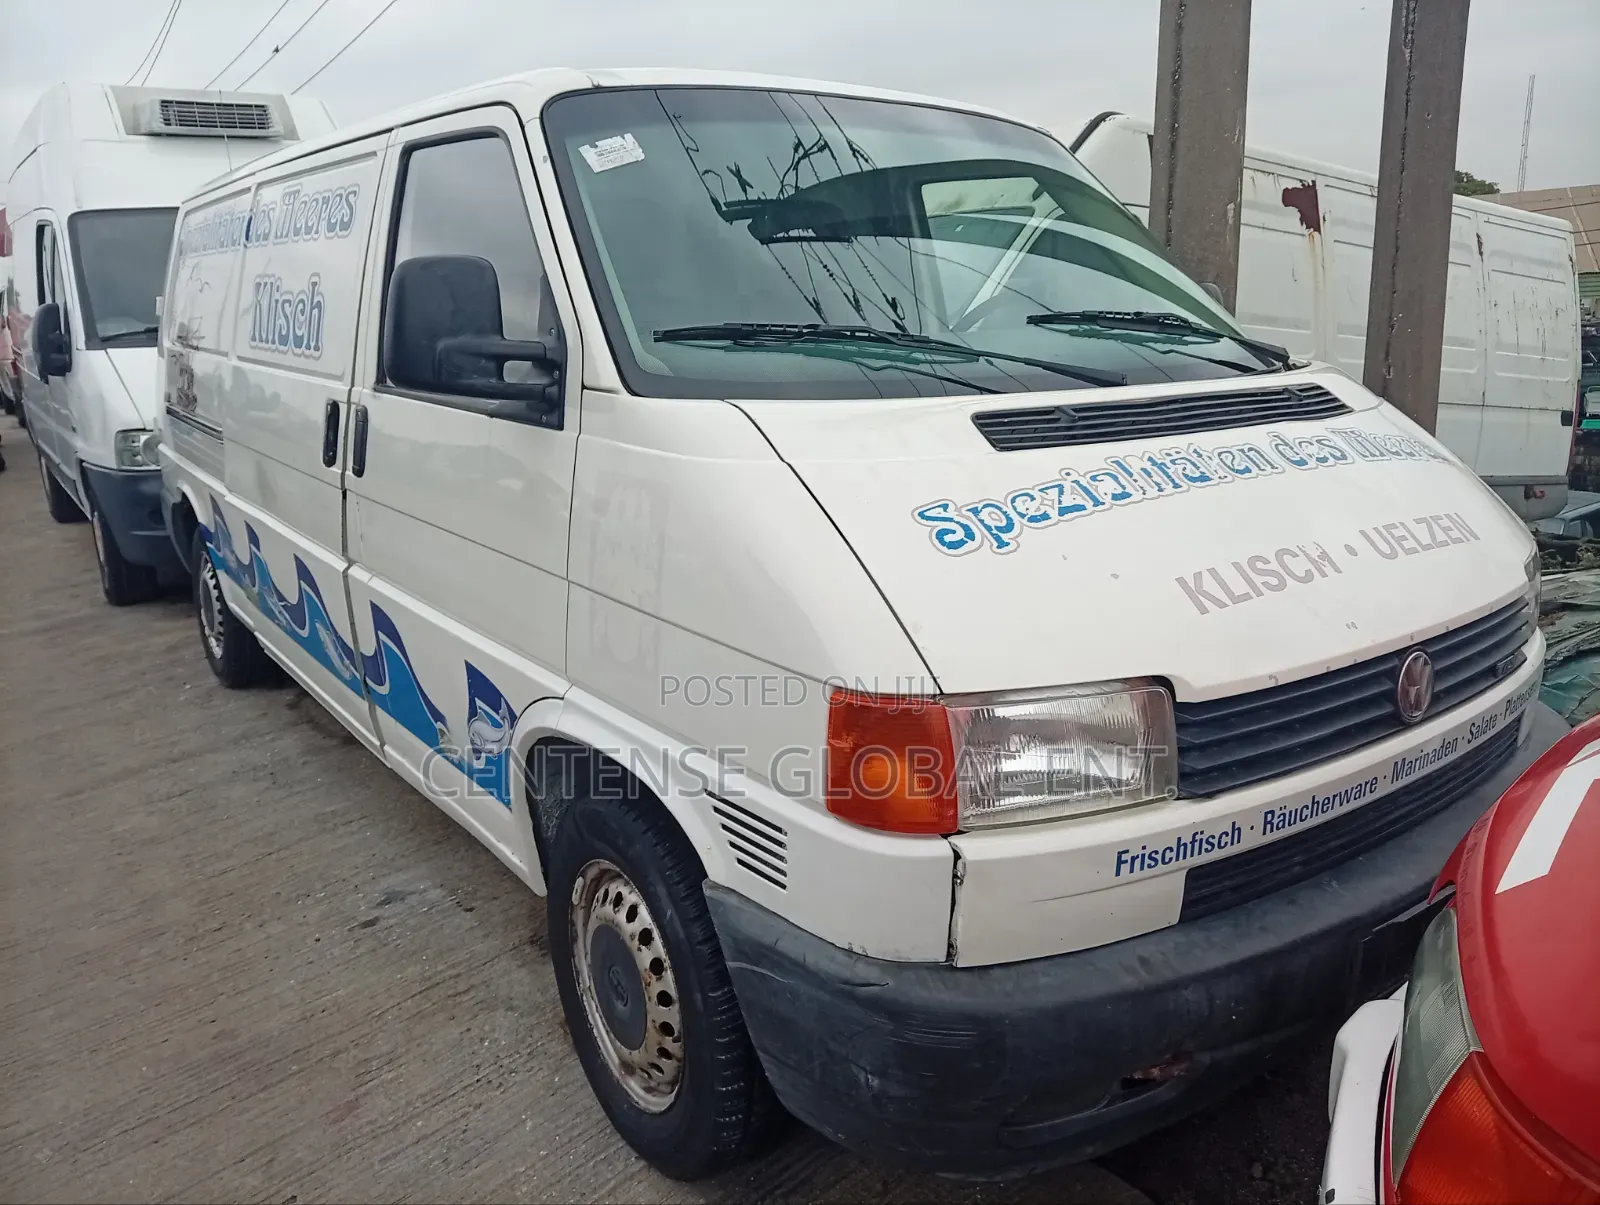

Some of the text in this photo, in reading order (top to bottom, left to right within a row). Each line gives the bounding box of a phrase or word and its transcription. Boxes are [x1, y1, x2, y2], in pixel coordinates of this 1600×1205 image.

[274, 183, 358, 243] Meeres
[250, 275, 325, 358] Klisch
[914, 428, 1444, 554] Spezialitäten des Meer
[1175, 512, 1481, 615] KLISCH UELZEN
[1114, 821, 1242, 878] Frischfisch
[1262, 774, 1379, 836] Räucherware
[1390, 736, 1459, 786] Marinaden
[1467, 713, 1499, 745] Salate
